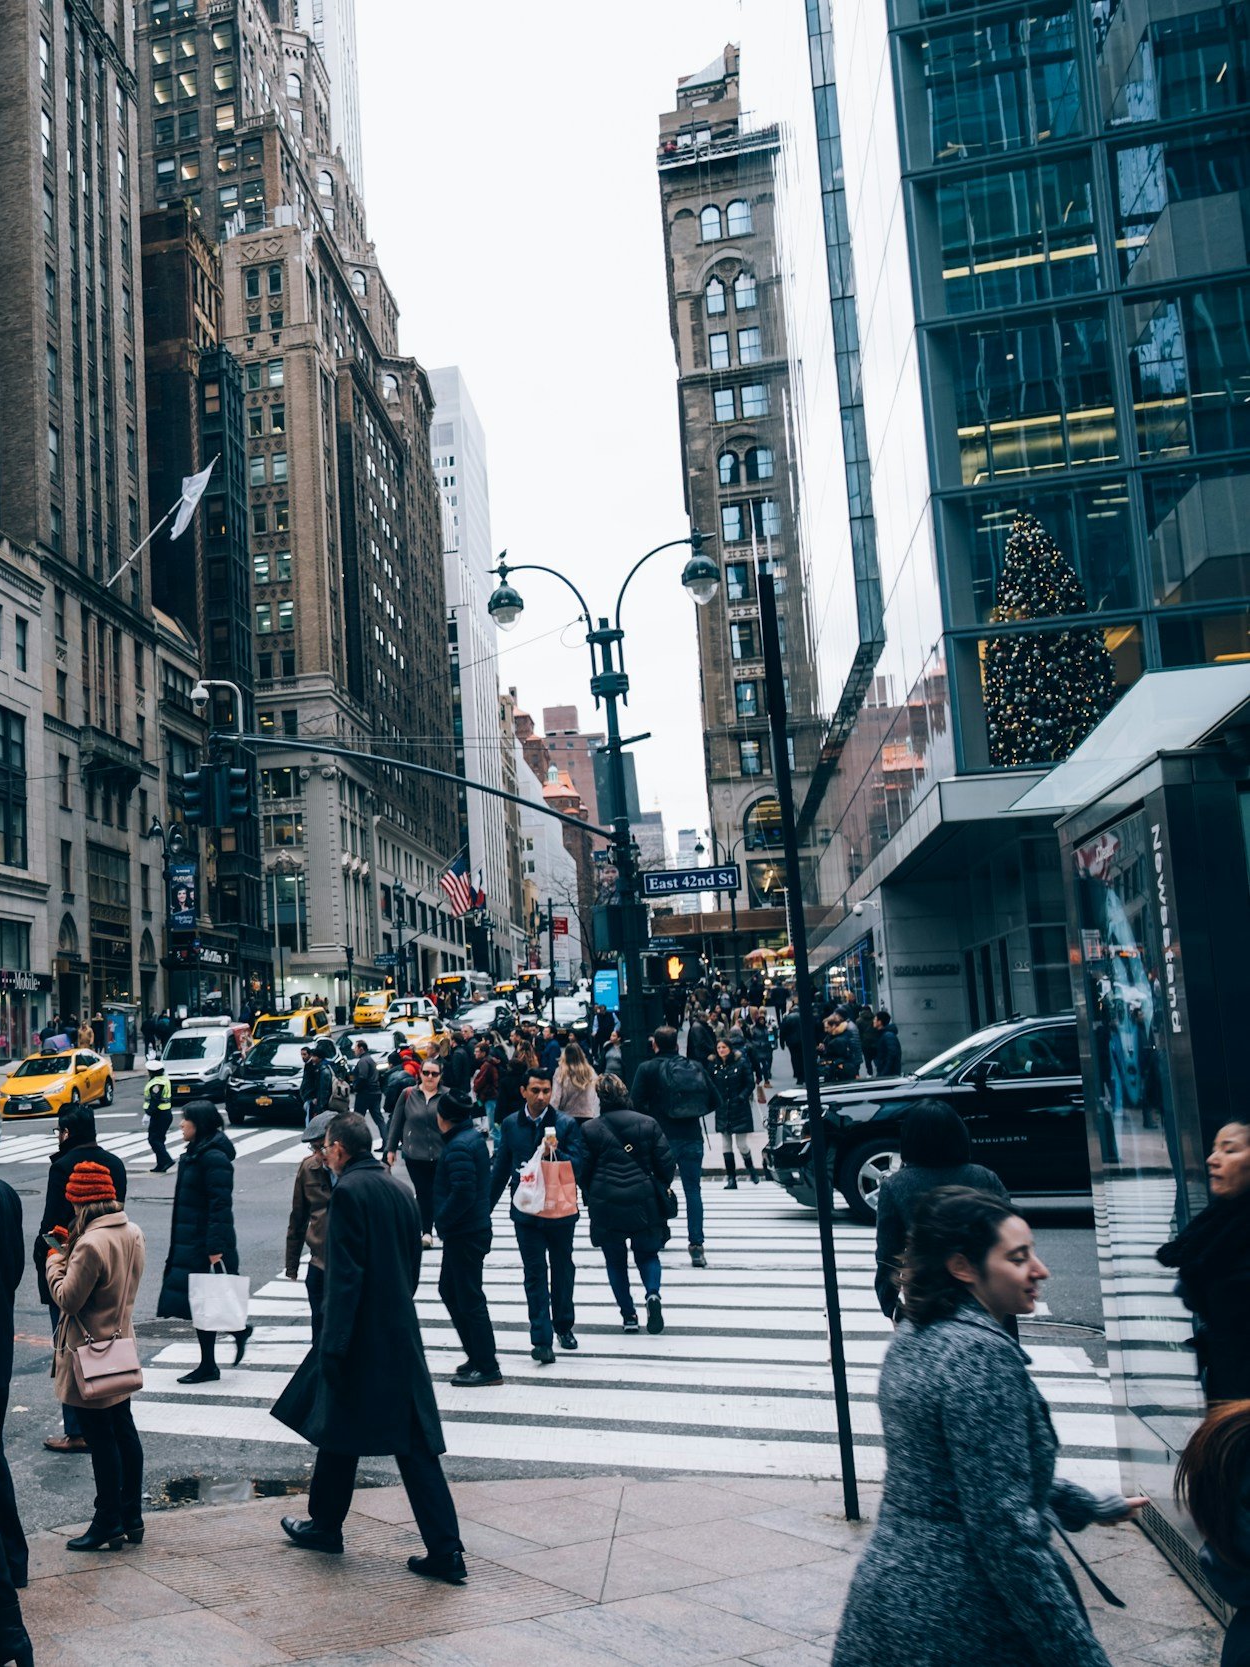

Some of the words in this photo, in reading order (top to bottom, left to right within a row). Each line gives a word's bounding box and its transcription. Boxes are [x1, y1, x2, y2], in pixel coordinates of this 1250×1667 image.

[648, 877, 679, 890] East
[682, 873, 715, 888] 42nd
[718, 872, 734, 885] St
[1151, 823, 1182, 1034] Newsstand
